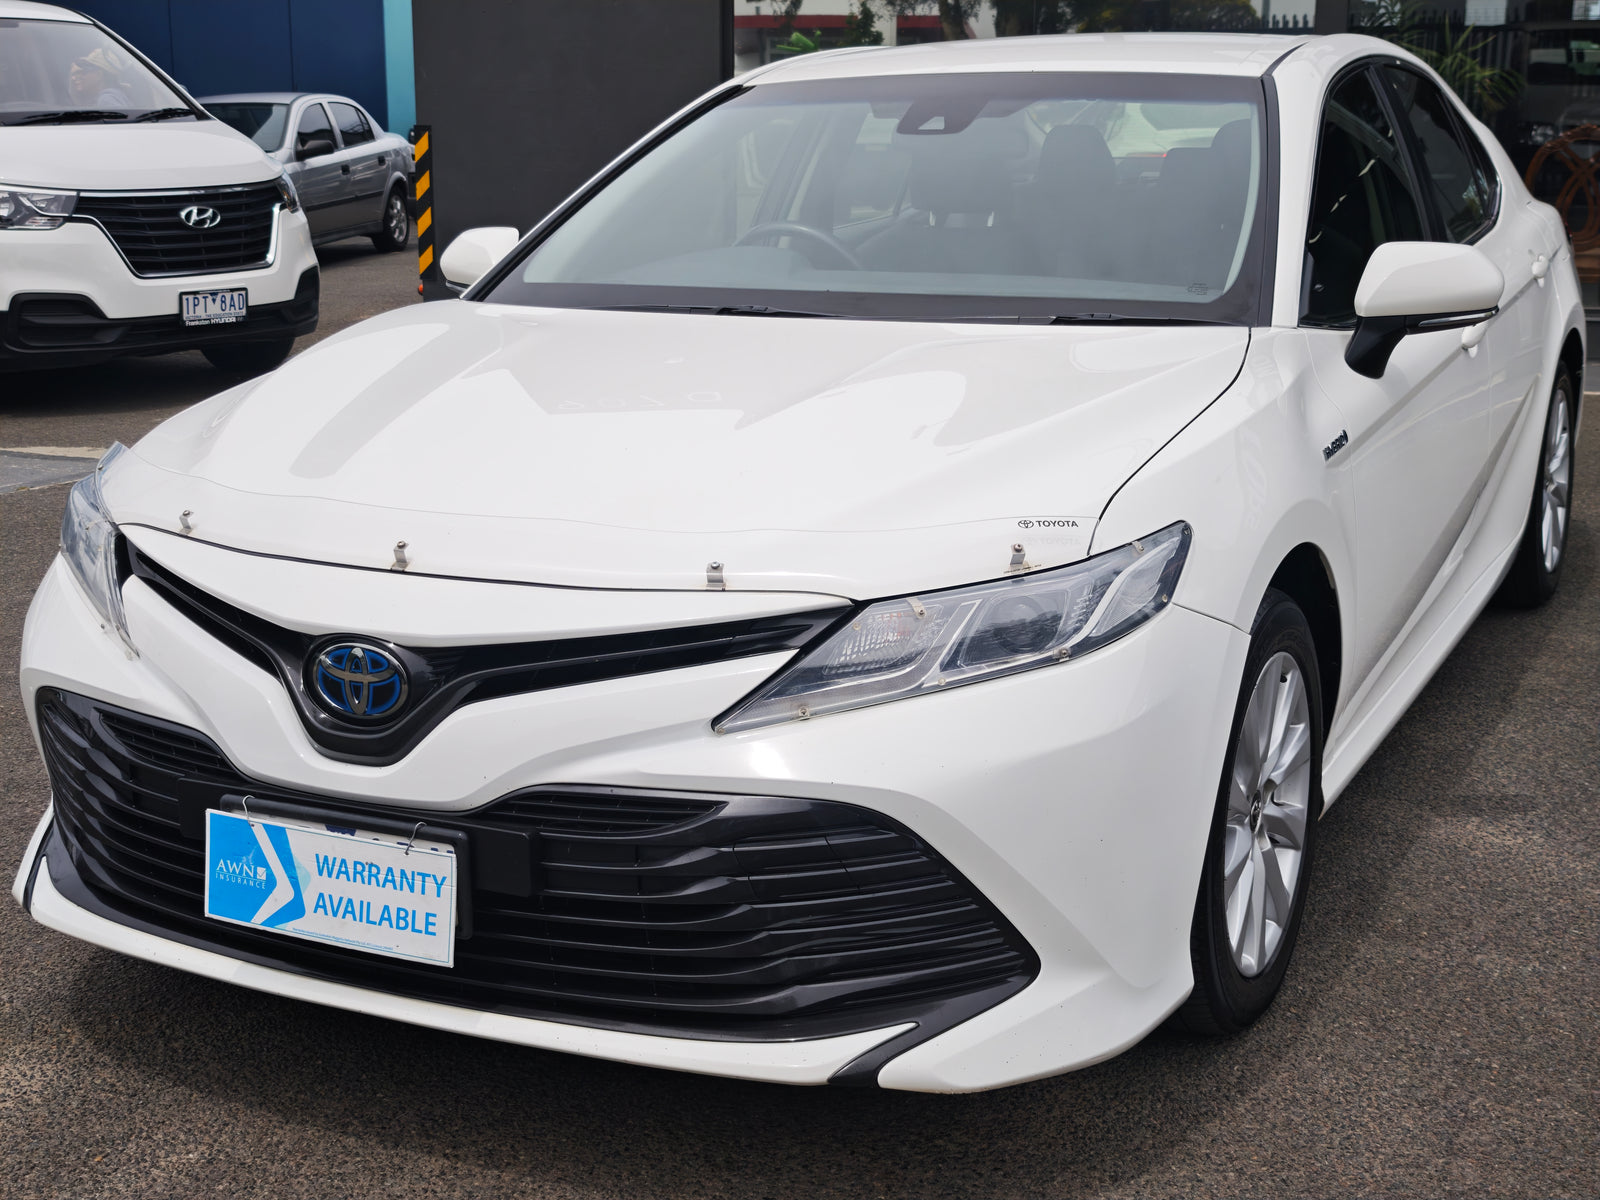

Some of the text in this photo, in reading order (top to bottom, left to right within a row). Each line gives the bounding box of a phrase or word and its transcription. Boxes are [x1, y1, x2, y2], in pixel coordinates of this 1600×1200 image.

[215, 872, 266, 890] INSURANCE
[216, 858, 255, 878] AWN
[315, 853, 447, 898] WARRANTY
[313, 892, 437, 937] AVAILABLE
